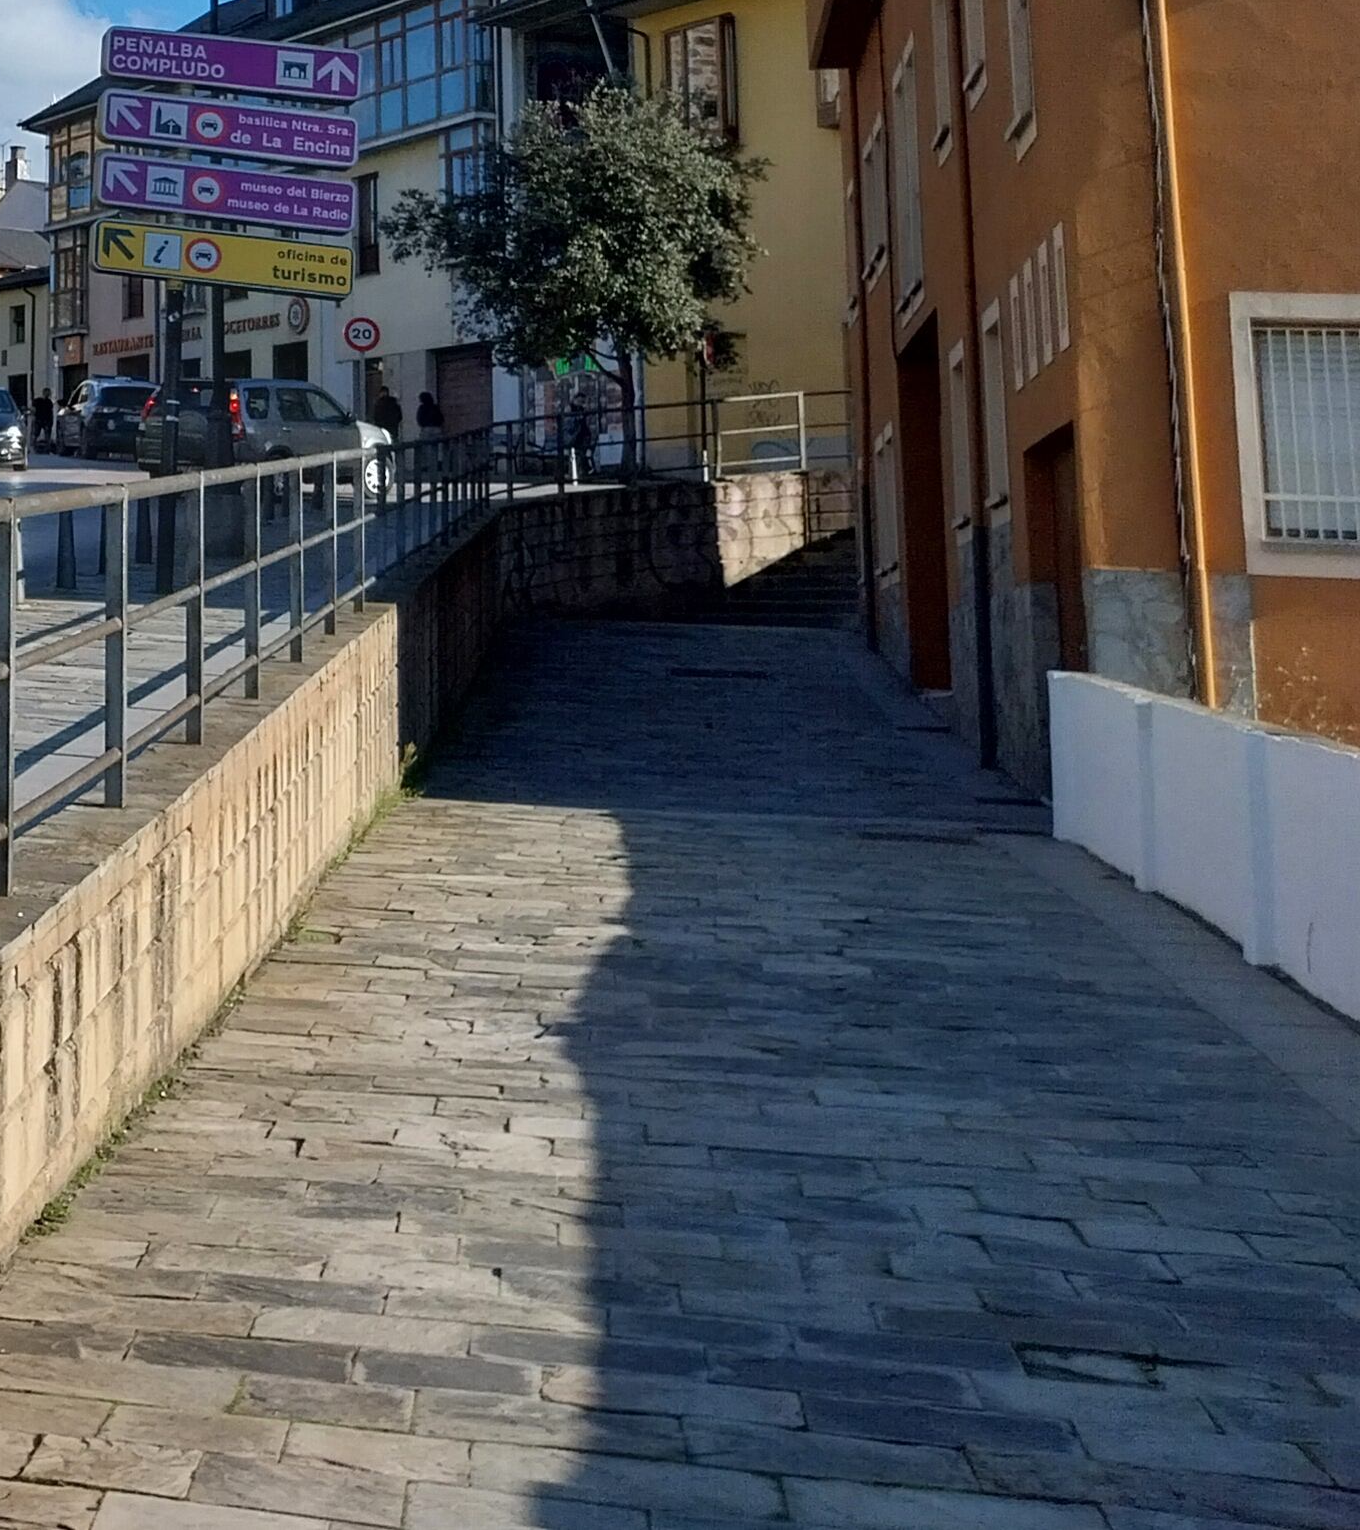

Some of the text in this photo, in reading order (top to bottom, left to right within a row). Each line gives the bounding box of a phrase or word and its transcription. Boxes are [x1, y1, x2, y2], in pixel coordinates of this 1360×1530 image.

[113, 36, 207, 60] PEÑALBA
[112, 54, 225, 78] COMPLUDO
[291, 119, 323, 133] Ntra.
[327, 124, 352, 137] Sra.
[230, 130, 351, 156] de La Encina
[240, 182, 350, 203] museo del Bierzo
[227, 198, 348, 221] museo de La Radio
[277, 249, 347, 266] oficina de
[272, 265, 347, 286] turismo
[352, 328, 372, 340] 20
